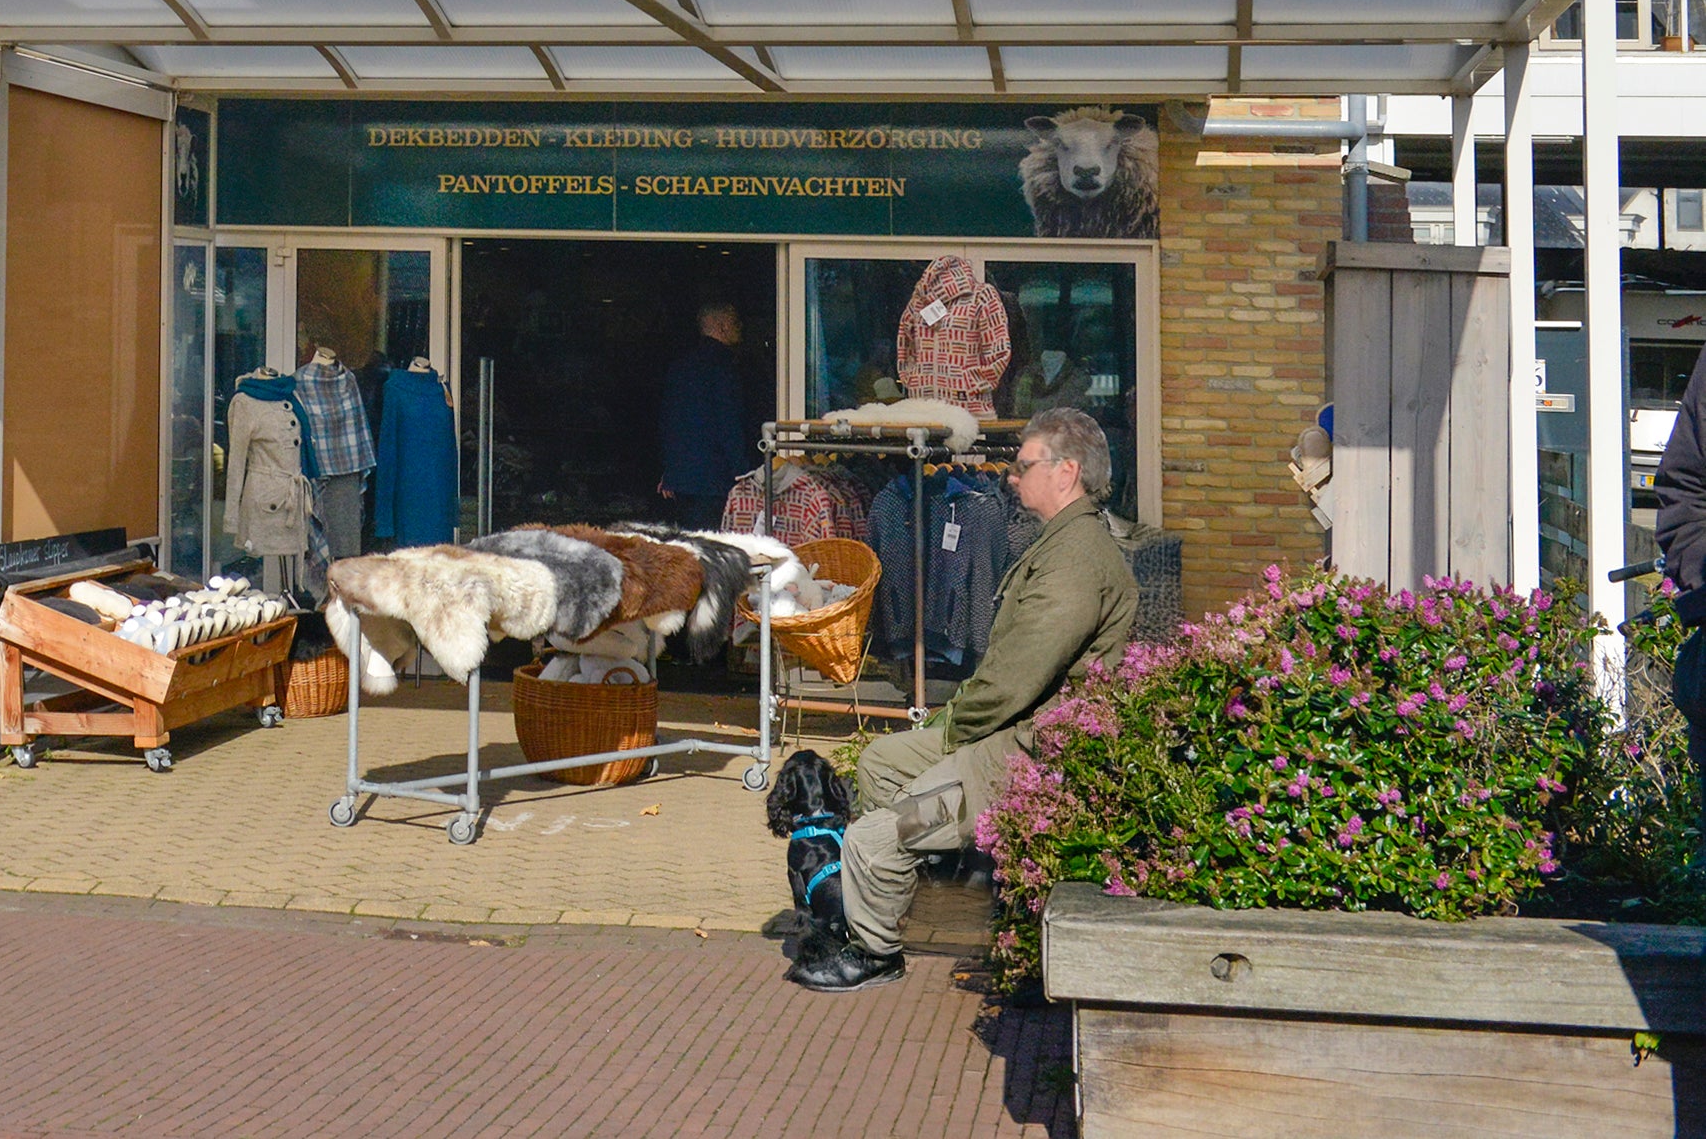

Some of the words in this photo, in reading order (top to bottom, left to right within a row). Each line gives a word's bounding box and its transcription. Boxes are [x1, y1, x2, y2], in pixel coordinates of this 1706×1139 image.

[368, 128, 542, 148] DEKBEDDEN
[563, 129, 693, 149] KLEDING
[715, 129, 984, 150] HUIDVERZORGING
[437, 175, 614, 195] PANTOFFELS
[635, 176, 906, 197] SCHAPENVACHTEN
